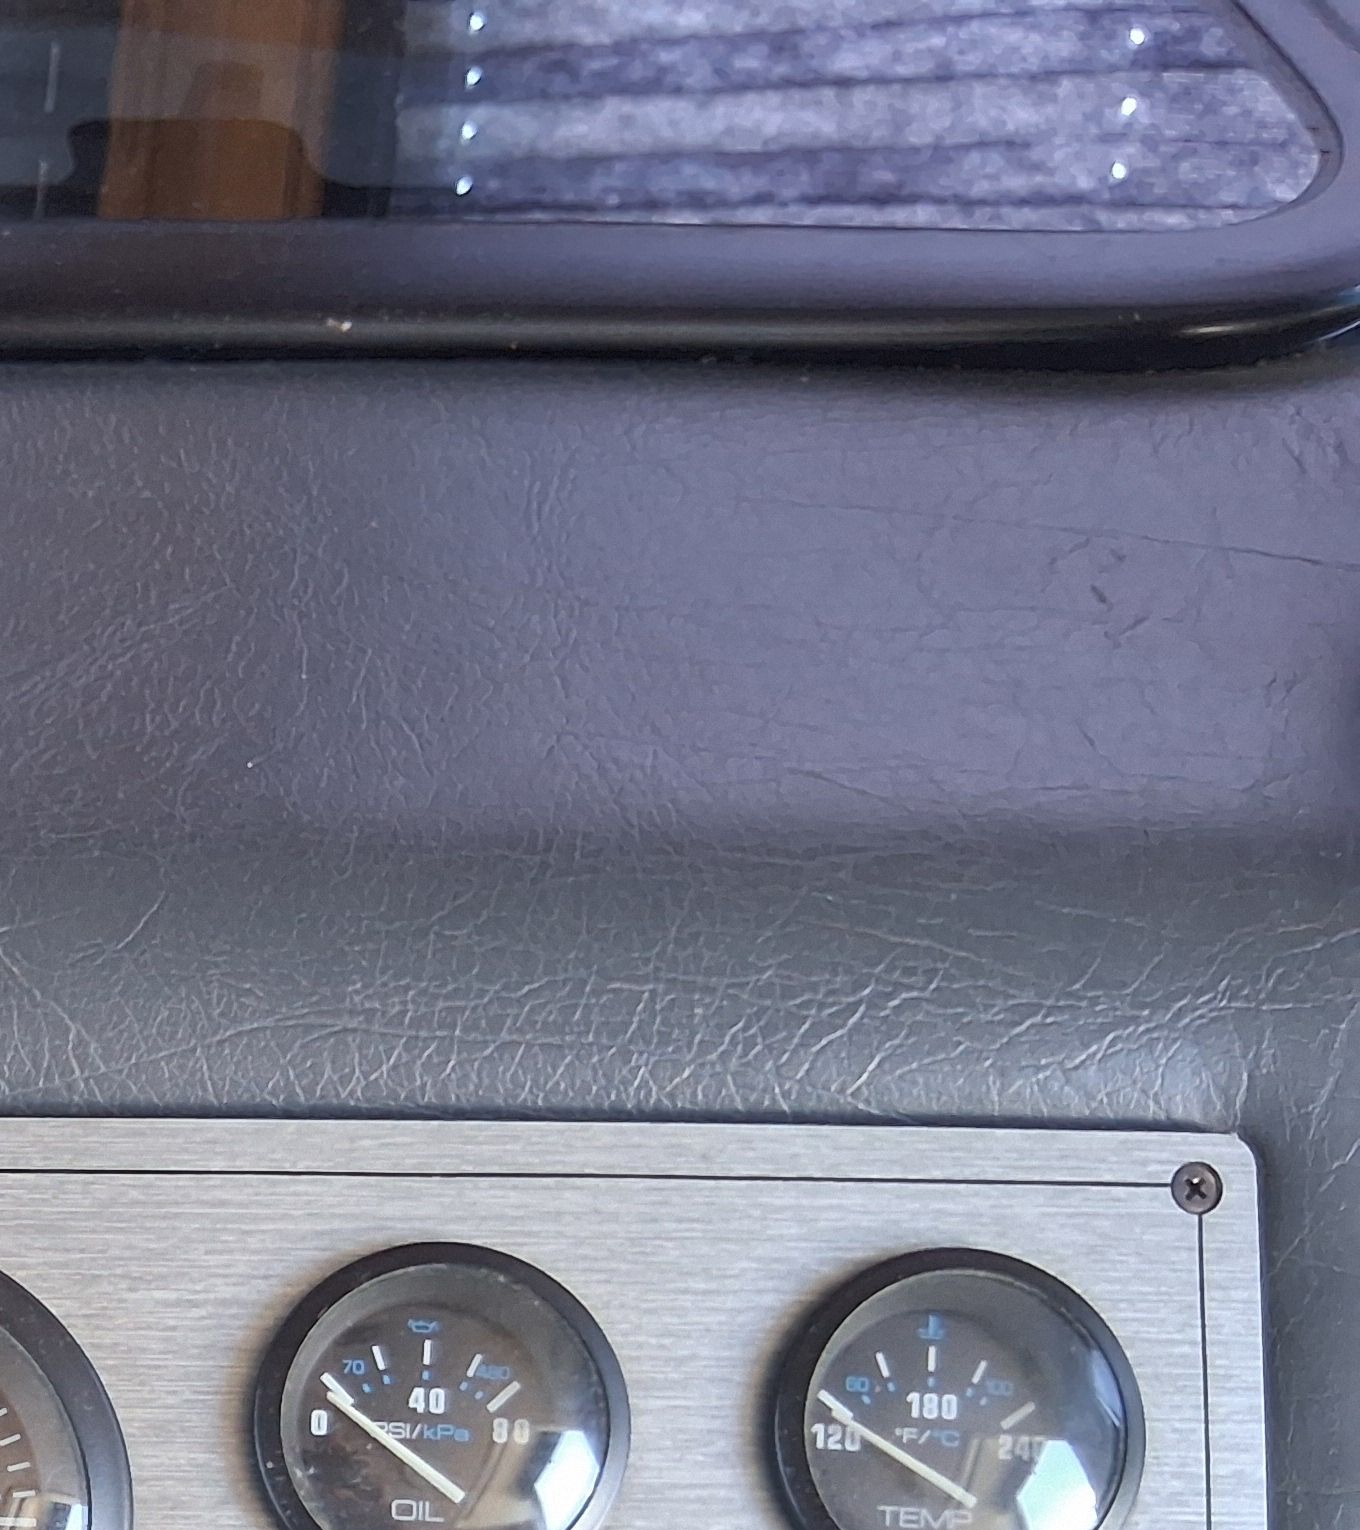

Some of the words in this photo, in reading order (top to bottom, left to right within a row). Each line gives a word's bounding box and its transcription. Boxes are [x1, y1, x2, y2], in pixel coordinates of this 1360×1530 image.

[407, 1386, 446, 1414] 40
[906, 1392, 959, 1420] 180
[310, 1409, 329, 1436] 0
[811, 1422, 863, 1452] 120
[390, 1498, 445, 1523] OIL
[877, 1504, 974, 1530] TEMP
